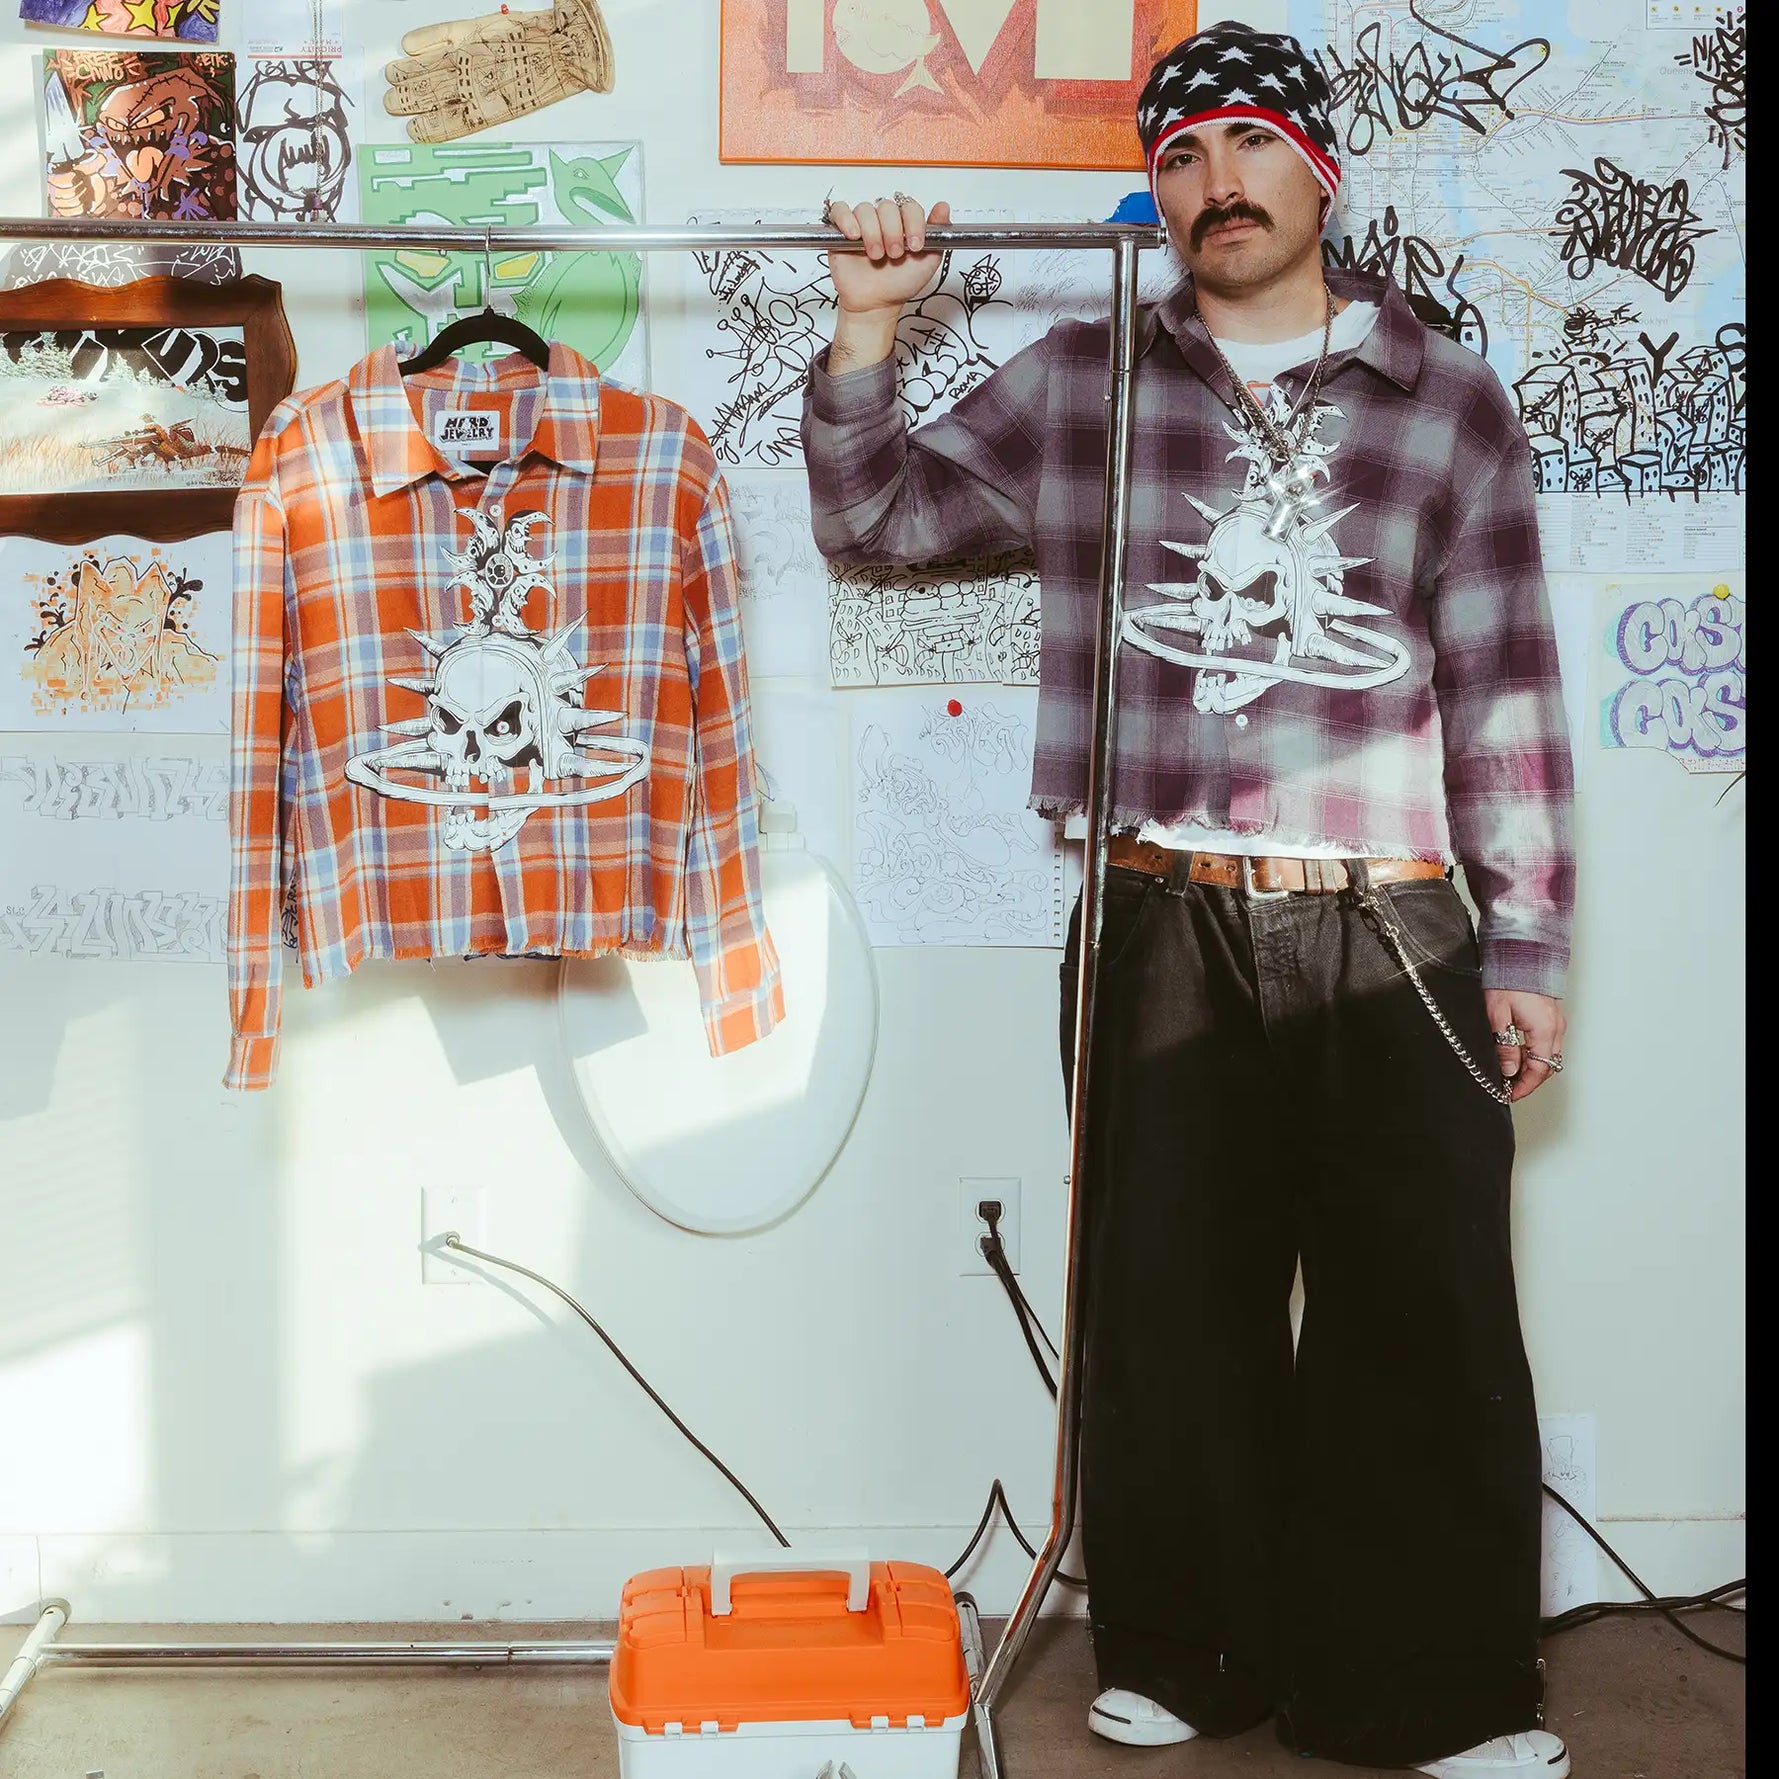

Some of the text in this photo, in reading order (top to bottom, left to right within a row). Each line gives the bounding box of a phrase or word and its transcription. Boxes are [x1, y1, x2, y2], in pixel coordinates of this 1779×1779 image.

[1658, 66, 1694, 76] Queens
[445, 416, 489, 428] HARD
[440, 427, 494, 441] JEWELRY
